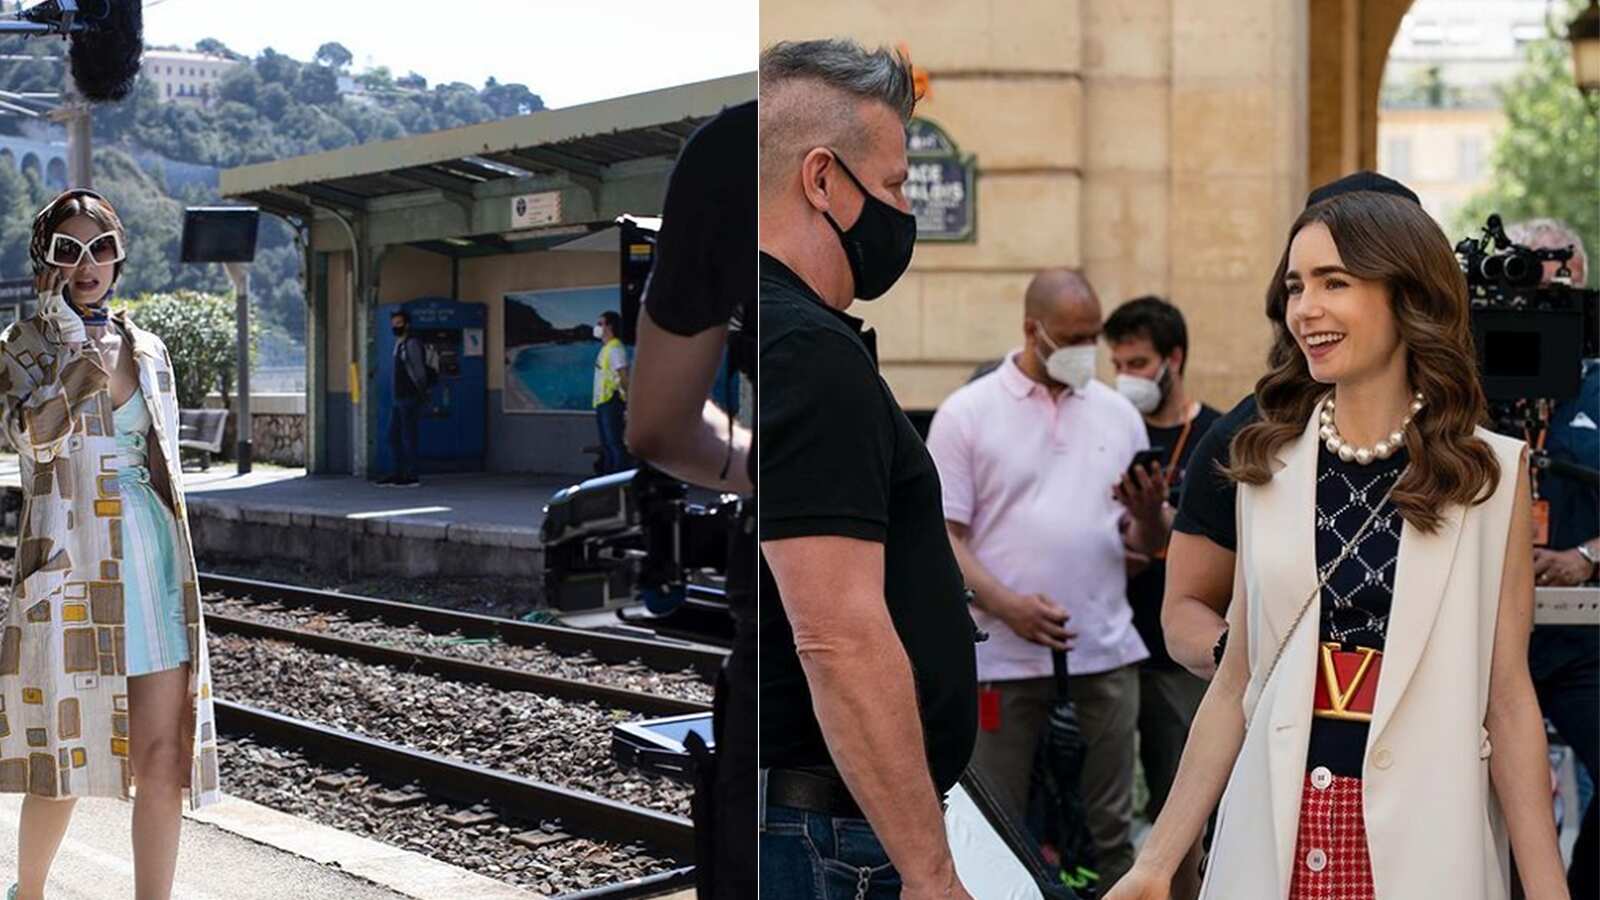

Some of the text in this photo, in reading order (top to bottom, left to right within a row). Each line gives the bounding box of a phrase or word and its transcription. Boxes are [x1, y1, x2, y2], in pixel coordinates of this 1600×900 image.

[907, 163, 942, 182] ACE
[902, 181, 964, 201] ALOIS
[1321, 642, 1377, 715] V
